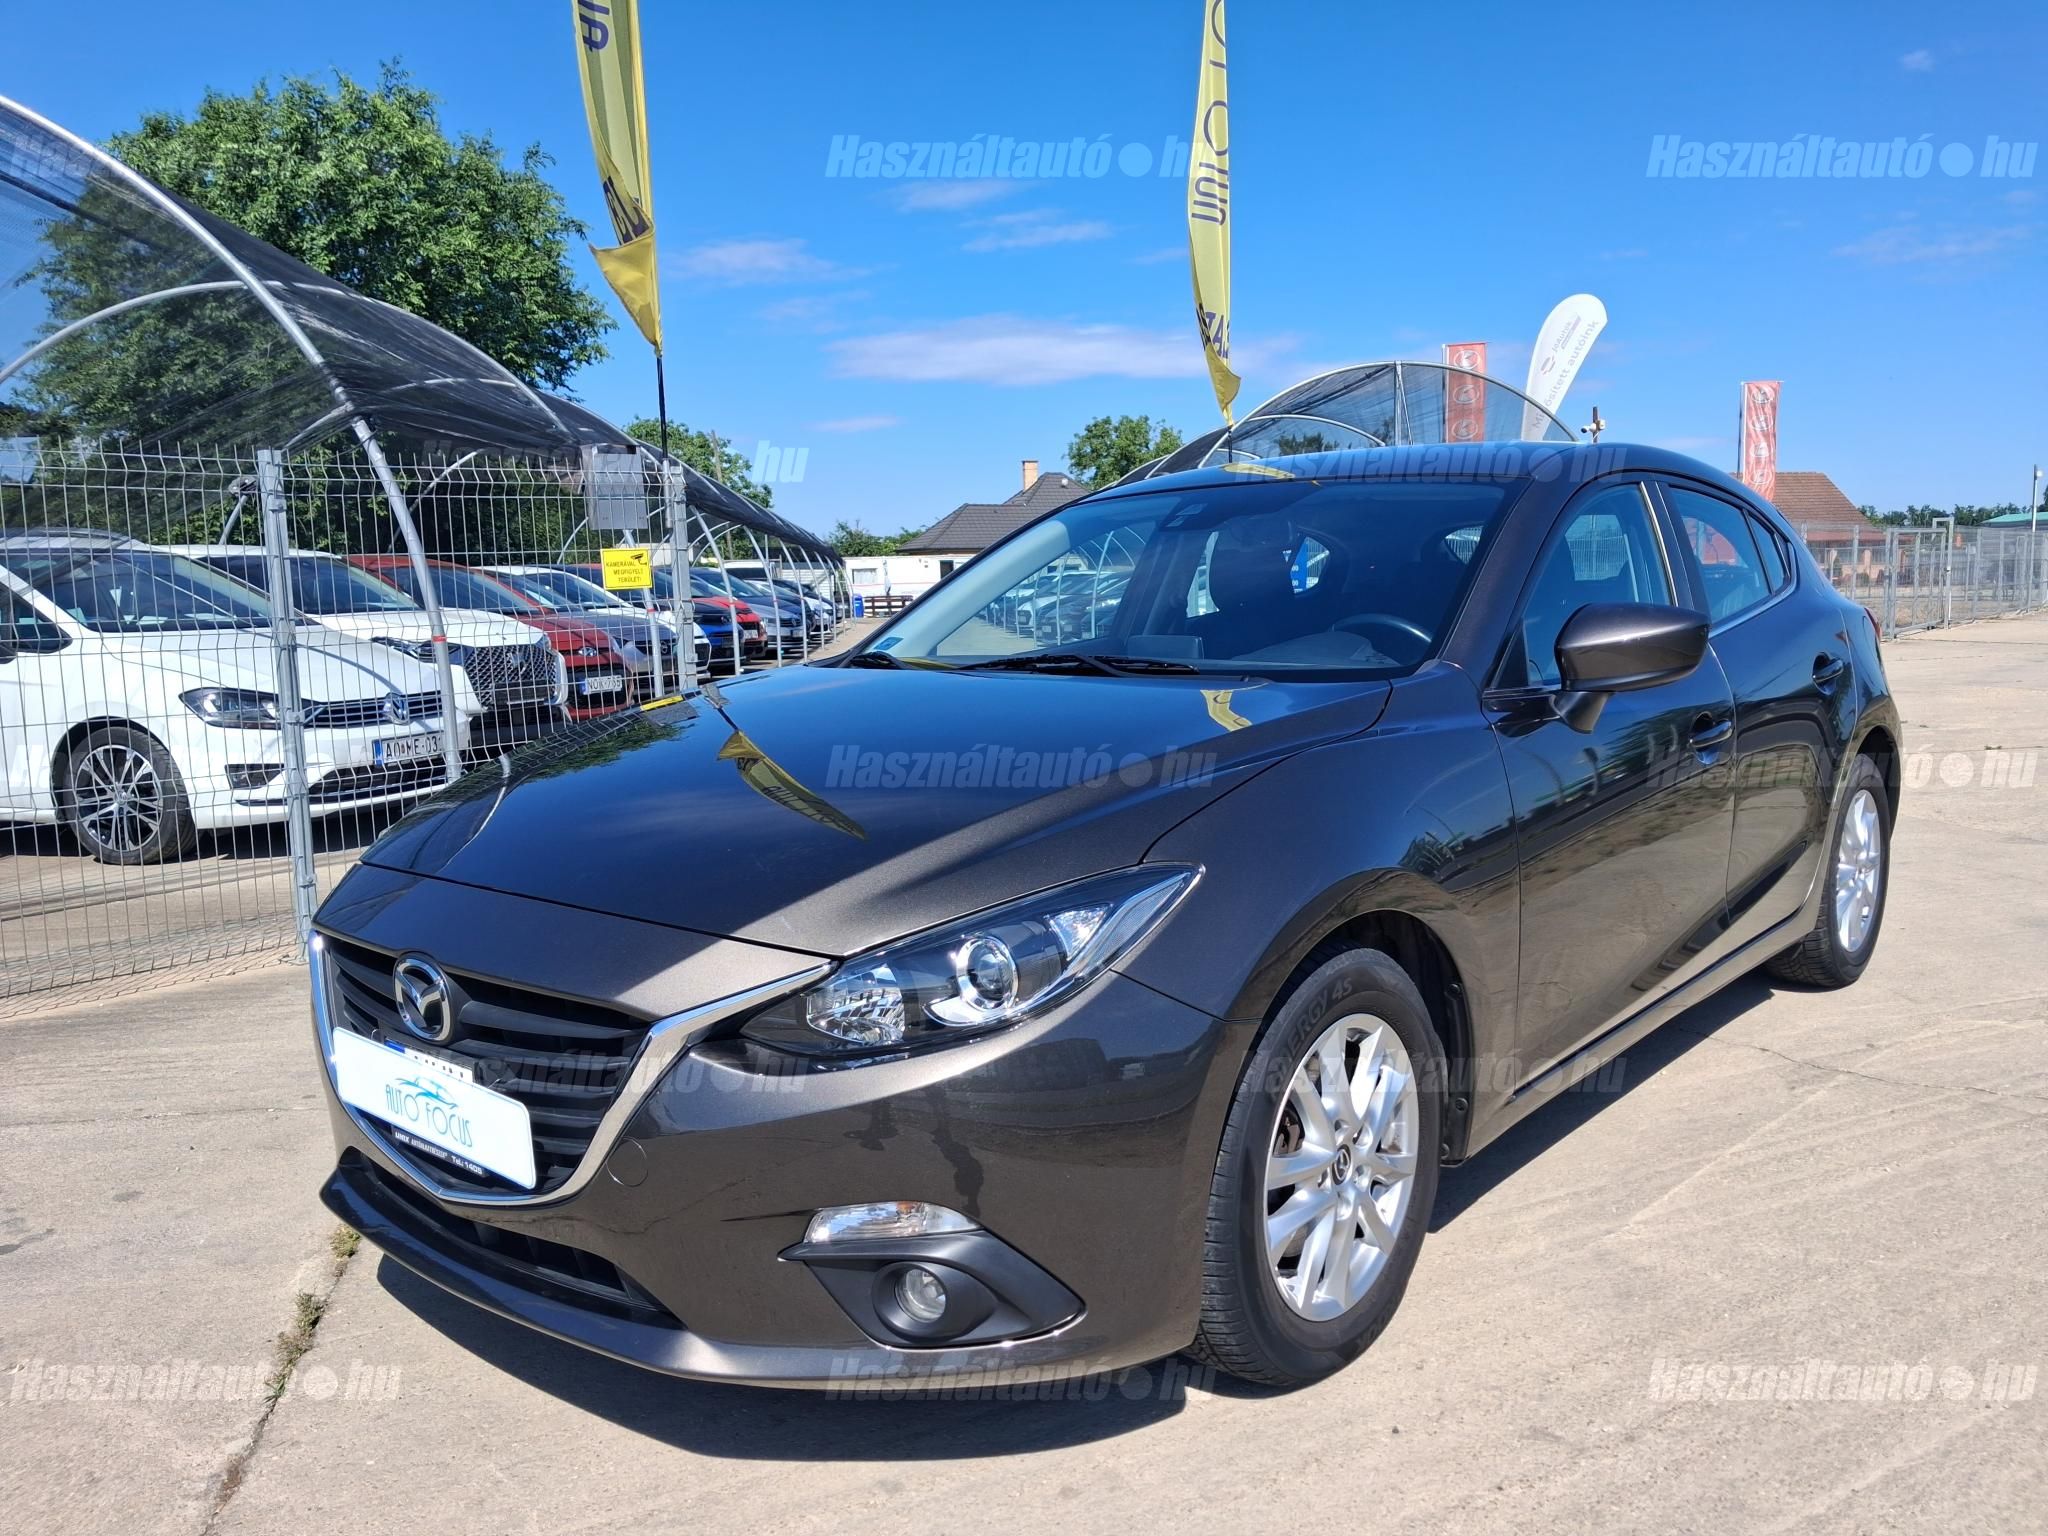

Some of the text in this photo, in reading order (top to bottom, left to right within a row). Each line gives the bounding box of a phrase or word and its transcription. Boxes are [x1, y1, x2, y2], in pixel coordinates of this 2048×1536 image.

[406, 735, 443, 756] ME-03
[386, 1084, 419, 1122] AUTO
[426, 1101, 473, 1148] FOCUS
